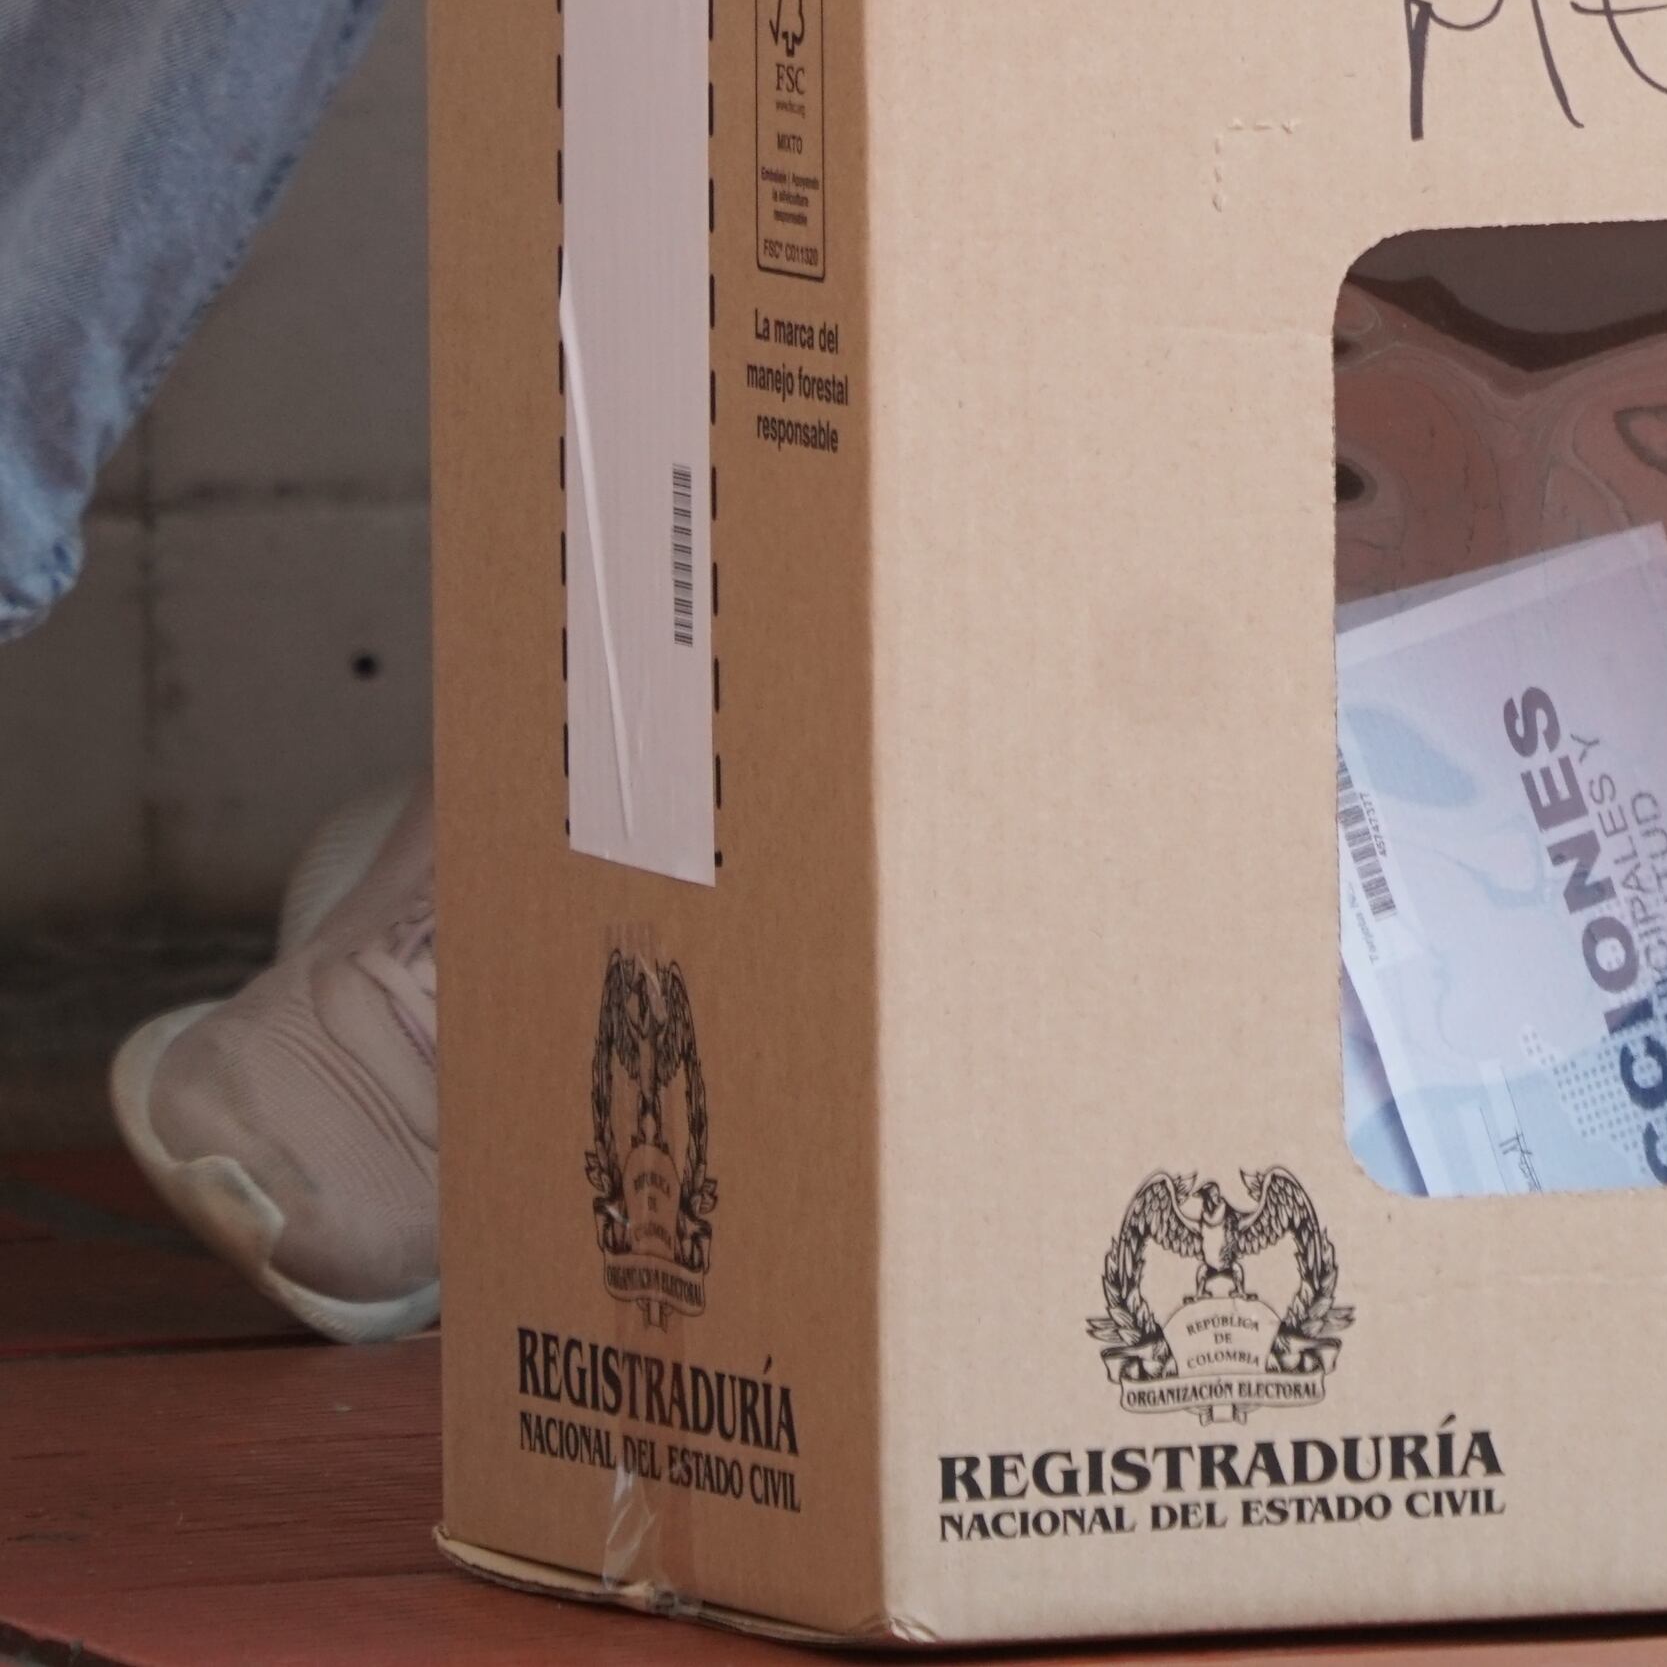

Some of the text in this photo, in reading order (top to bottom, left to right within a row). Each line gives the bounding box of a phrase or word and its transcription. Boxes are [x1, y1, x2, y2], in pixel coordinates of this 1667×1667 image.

[776, 63, 806, 94] FSC
[755, 309, 838, 354] La marca del
[747, 361, 848, 405] manejo forestal
[757, 413, 839, 453] responsable
[1570, 733, 1600, 763] Y
[1187, 1314, 1260, 1335] REPÚBLICA
[1214, 1333, 1232, 1345] DE
[1187, 1351, 1260, 1370] COLOMBIA
[517, 1326, 800, 1456] REGISTRADURÍA
[1127, 1377, 1320, 1407] ORGANIZACIÓN ELECTORAL
[519, 1410, 801, 1514] NACIONAL DEL ESTADO CIVIL
[939, 1414, 1504, 1502] REGISTRADURÍA
[939, 1486, 1506, 1542] NACIONAL DEL ESTADO CIVIL
